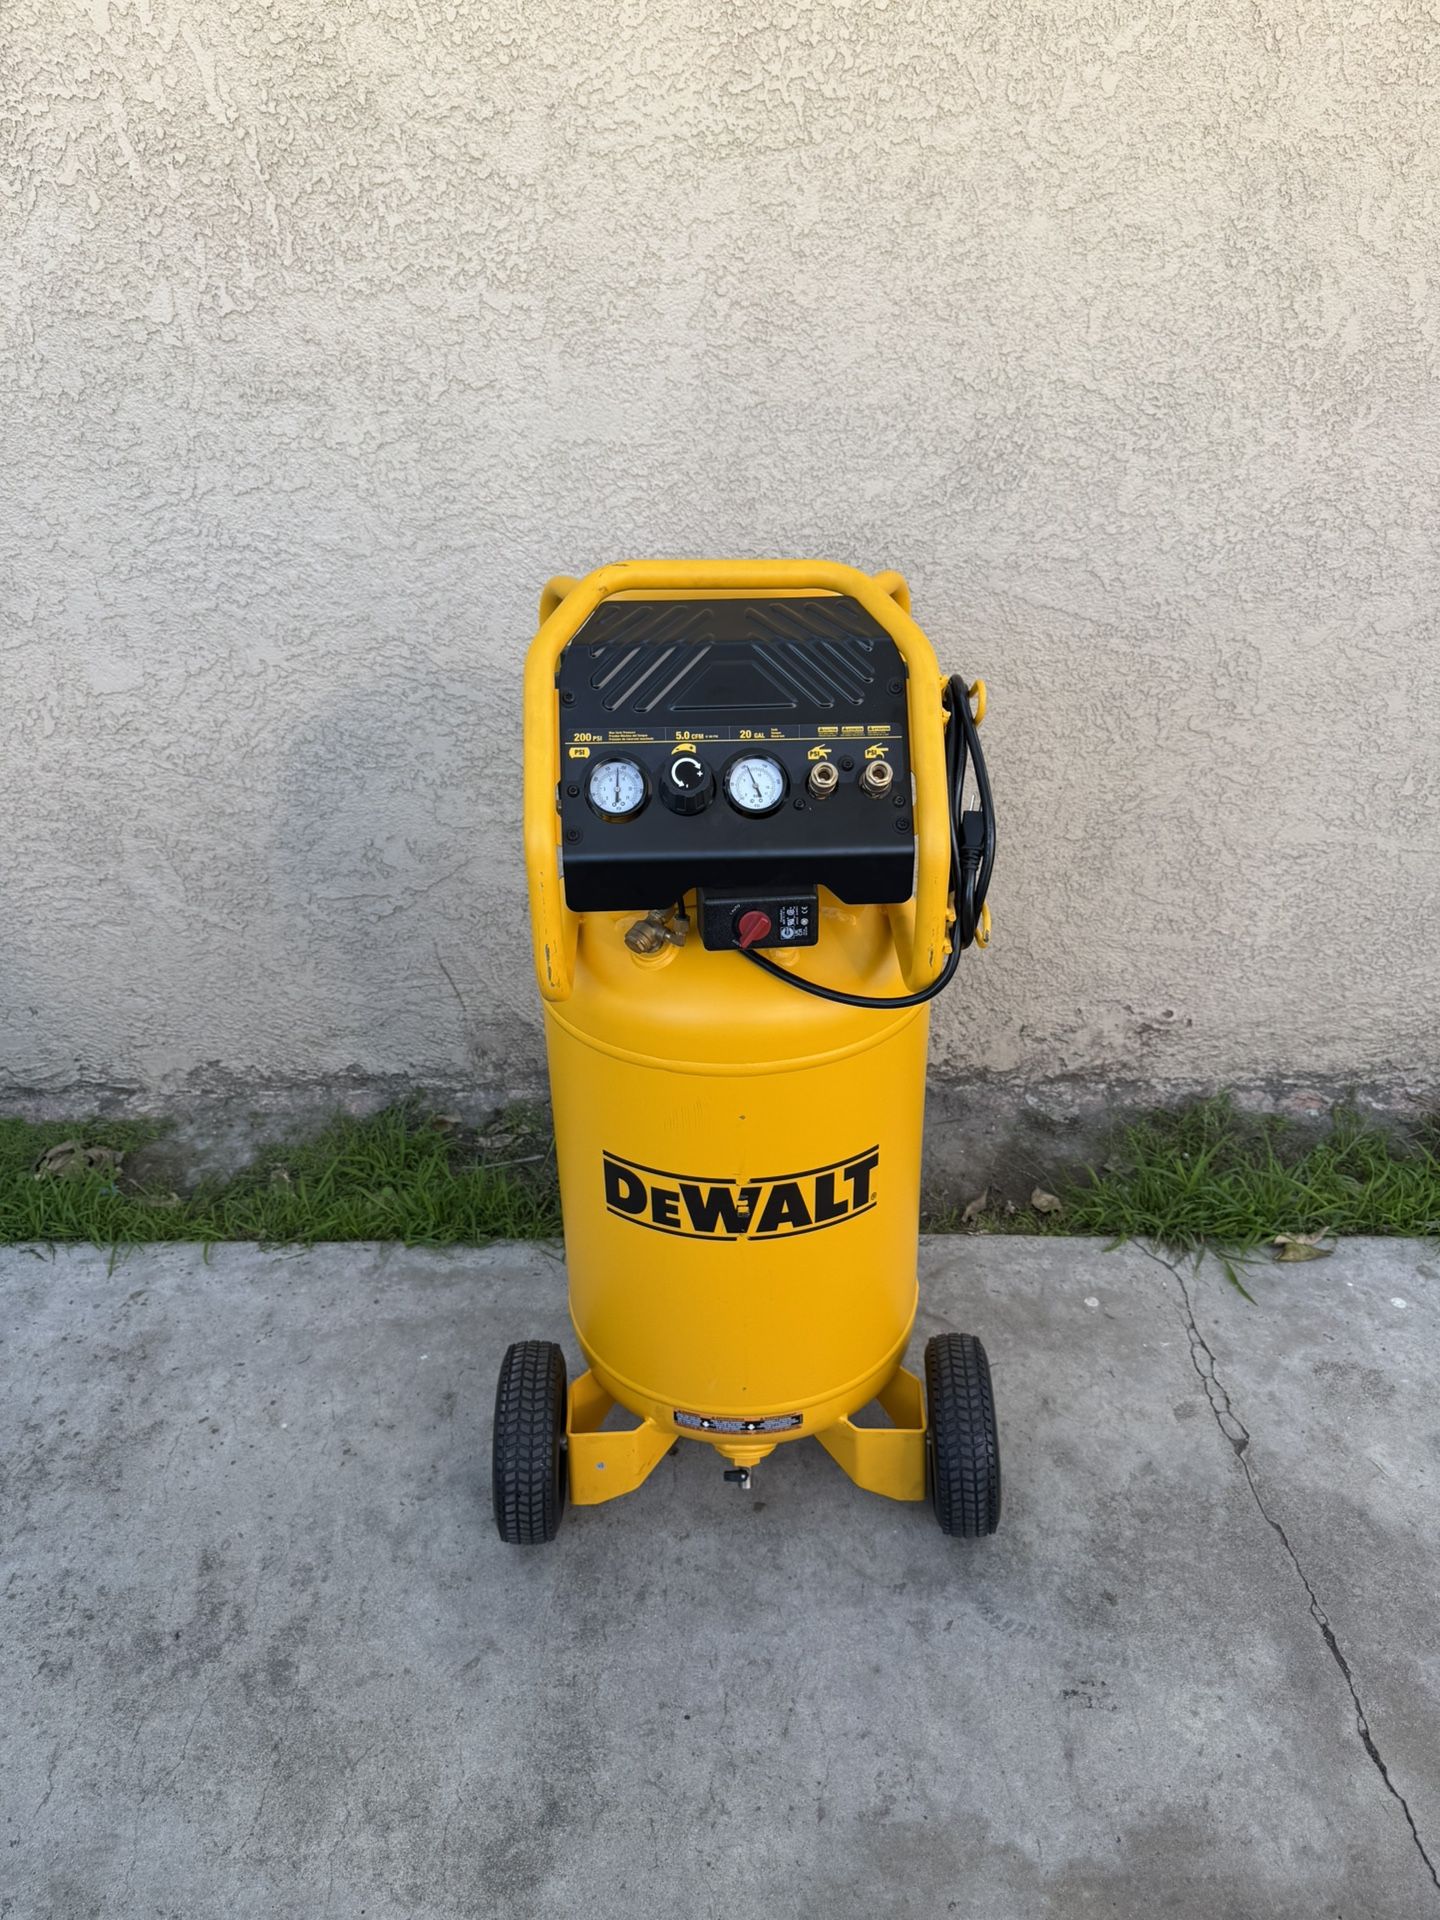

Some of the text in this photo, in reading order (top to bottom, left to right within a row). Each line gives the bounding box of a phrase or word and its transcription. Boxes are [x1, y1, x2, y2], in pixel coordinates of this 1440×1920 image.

[573, 733, 592, 742] 200
[675, 731, 690, 740] 5.0
[739, 729, 752, 739] 20
[603, 1152, 879, 1233] DEWALT
